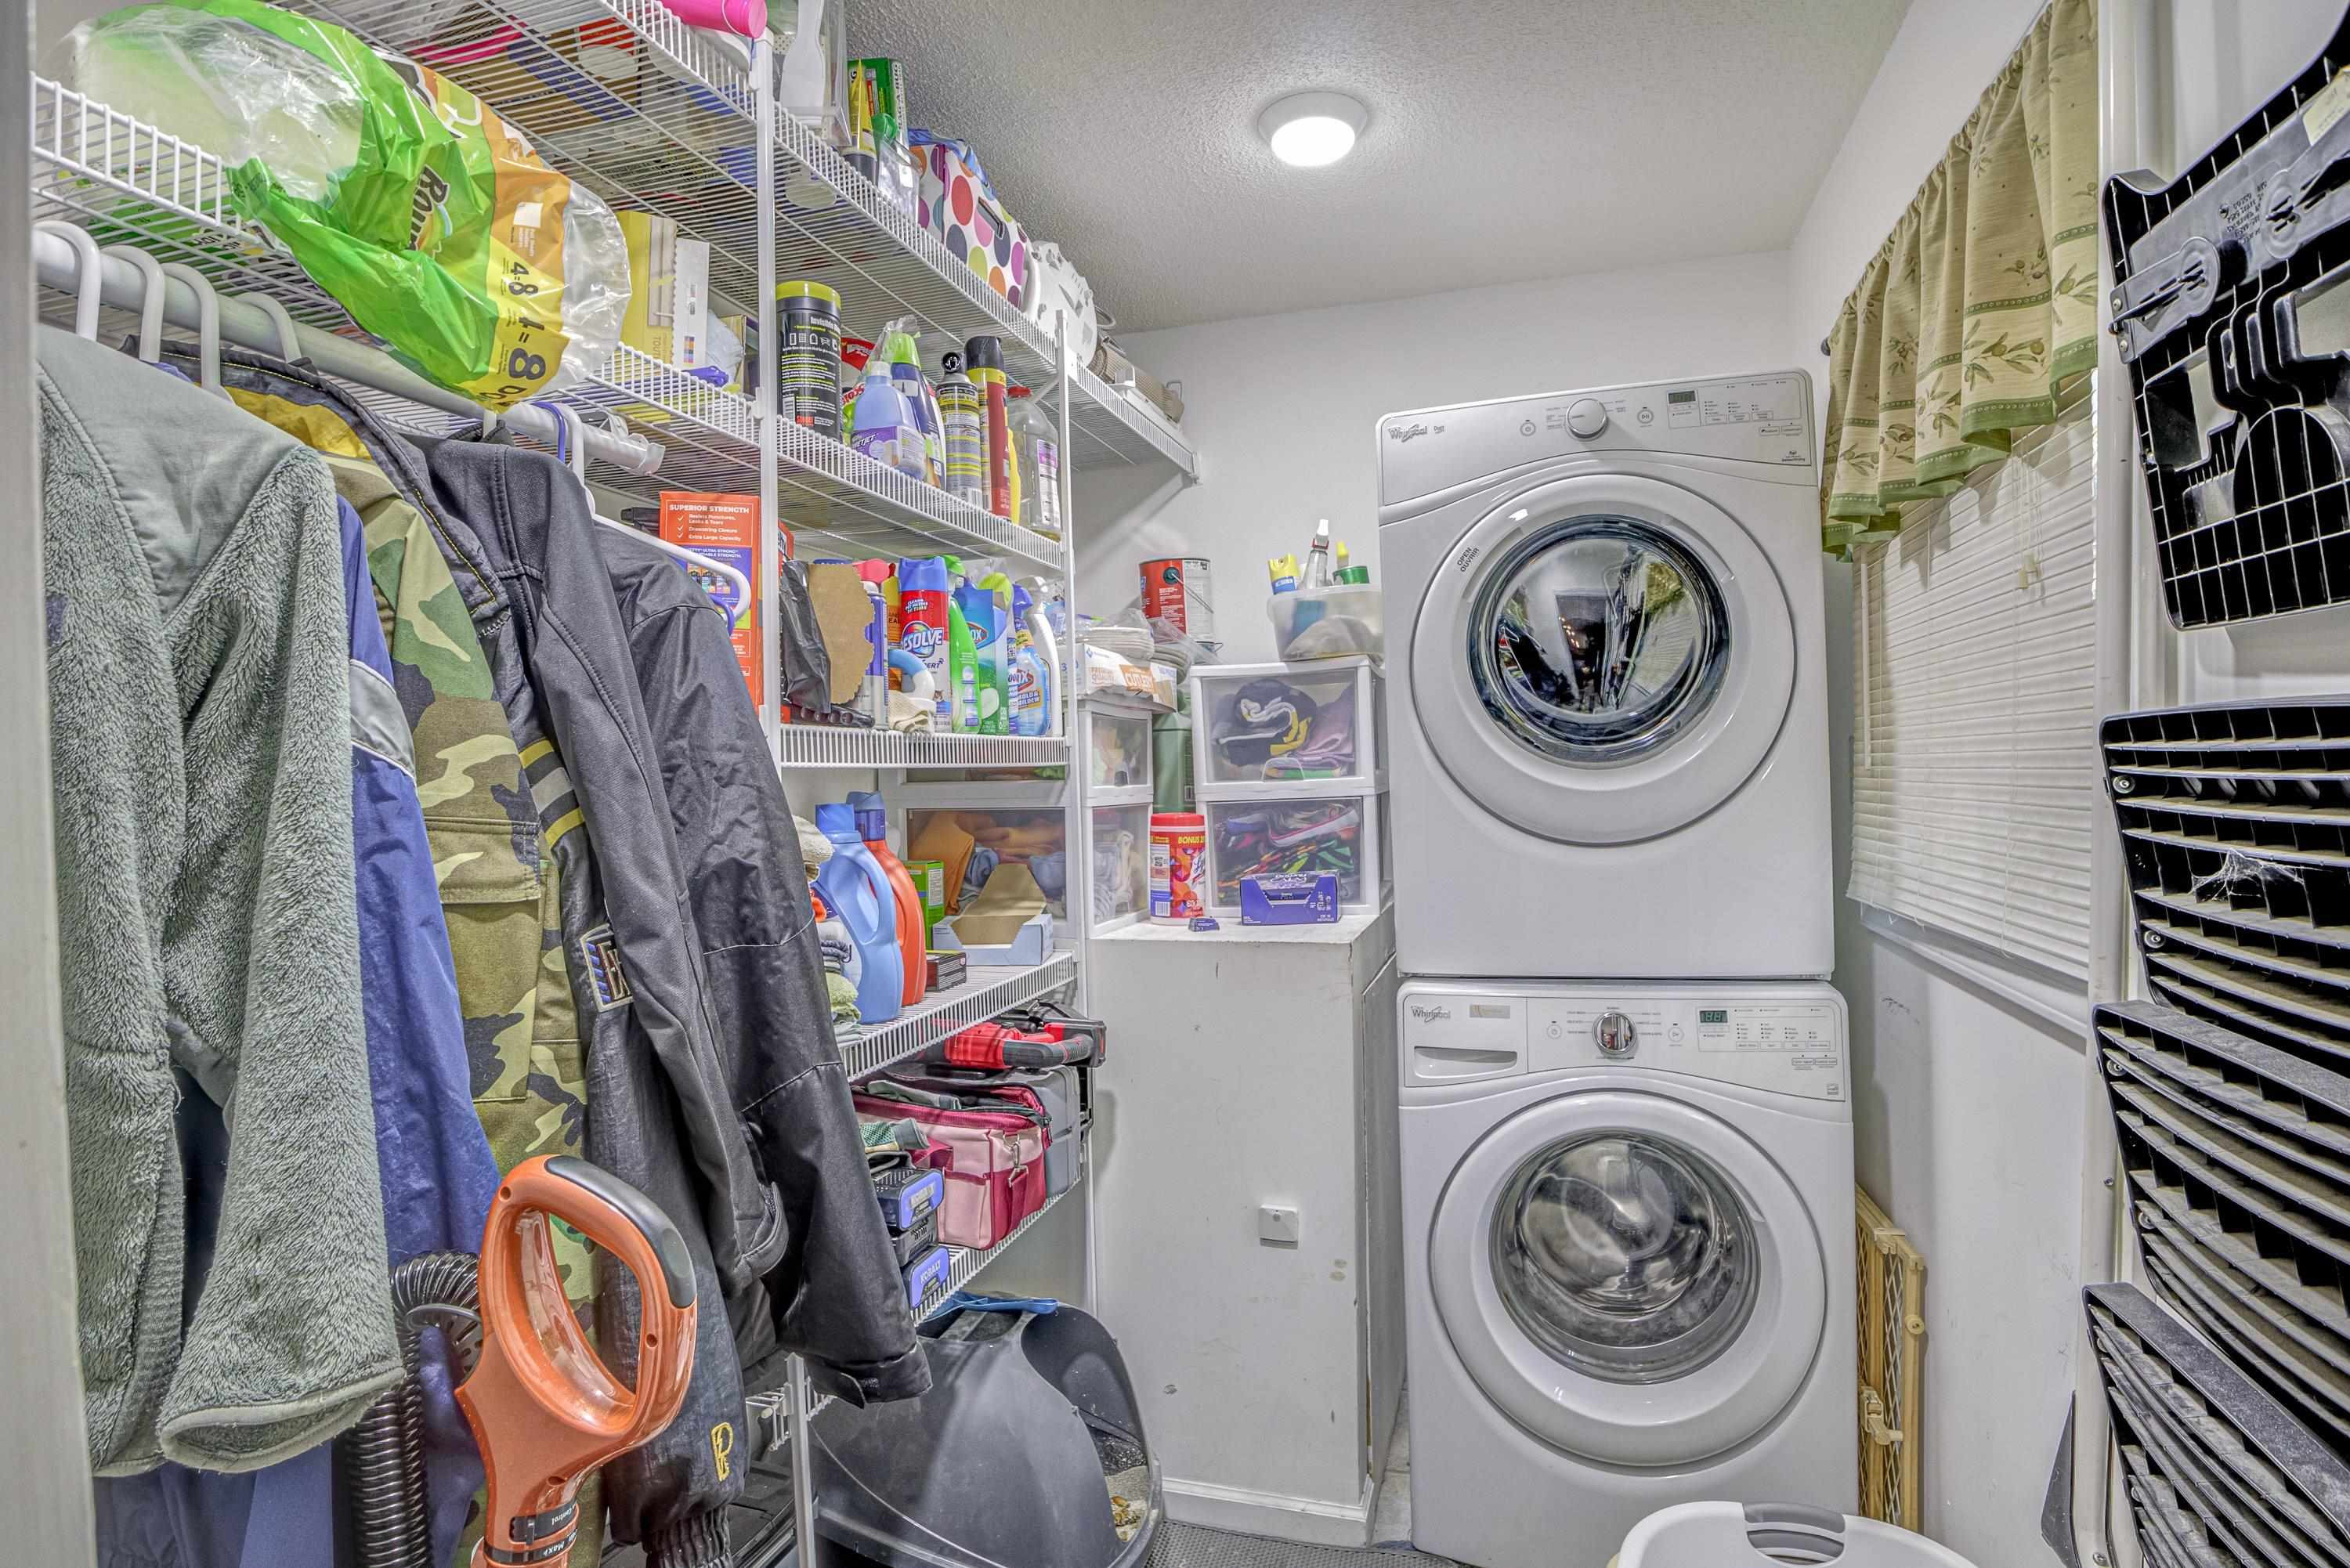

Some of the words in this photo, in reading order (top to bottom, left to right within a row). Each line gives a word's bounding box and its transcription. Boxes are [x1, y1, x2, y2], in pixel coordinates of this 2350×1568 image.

[670, 504, 707, 512] SUPERIOR
[709, 505, 750, 514] STRENGTH
[1457, 547, 1472, 566] OPEN
[1460, 547, 1480, 573] OUVRIR
[1411, 1006, 1452, 1023] Whirlpool
